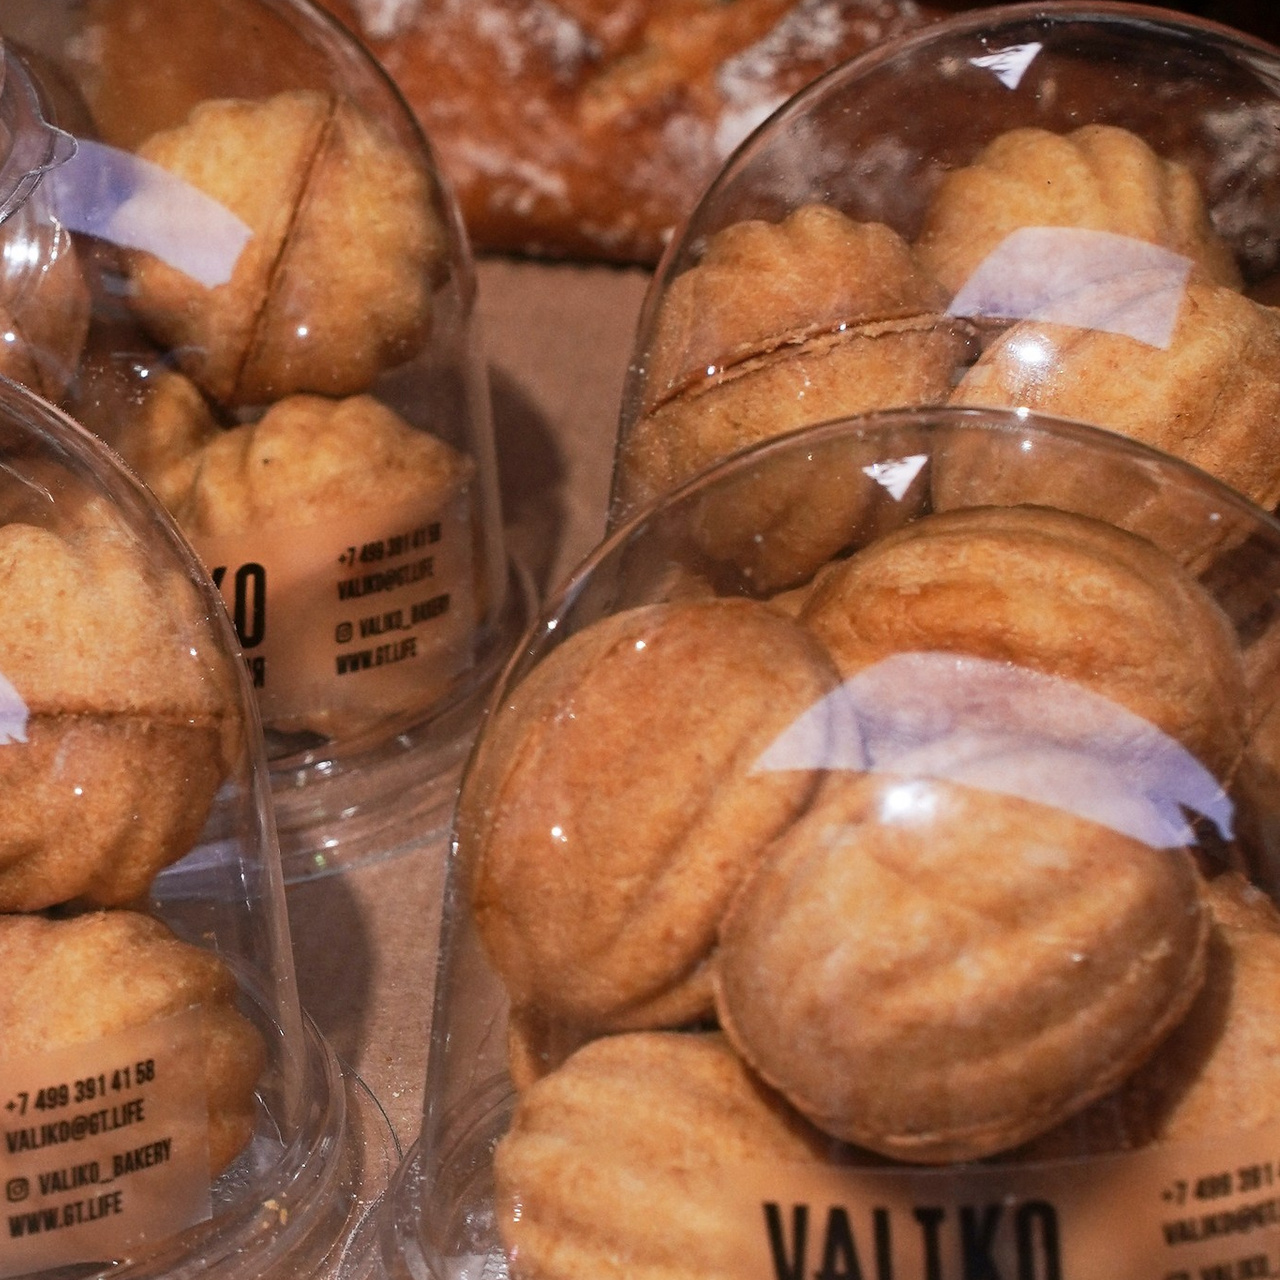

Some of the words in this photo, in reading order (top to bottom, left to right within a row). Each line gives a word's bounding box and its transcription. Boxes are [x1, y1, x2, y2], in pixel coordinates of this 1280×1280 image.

[5, 1092, 29, 1116] +7
[34, 1083, 69, 1112] 499
[74, 1074, 106, 1103] 391
[111, 1066, 131, 1091] 41
[135, 1059, 155, 1085] 58
[5, 1098, 145, 1154] VALIKO@GT.LIFE
[38, 1136, 173, 1196] VALIKO_BAKERY
[7, 1189, 123, 1238] WWW.GT.LIFE
